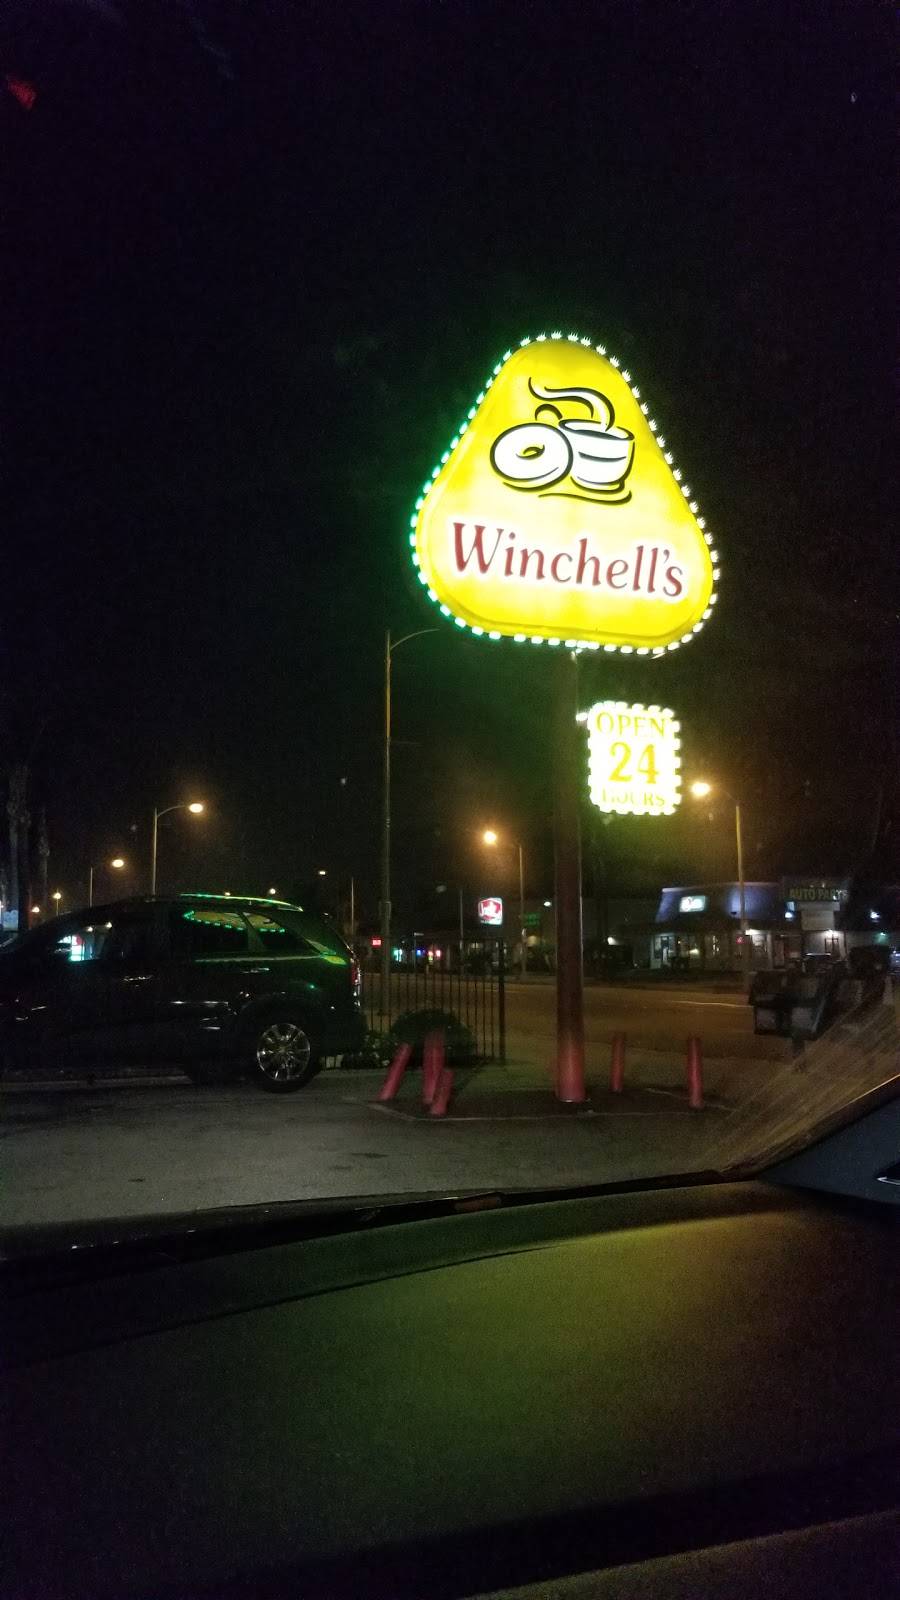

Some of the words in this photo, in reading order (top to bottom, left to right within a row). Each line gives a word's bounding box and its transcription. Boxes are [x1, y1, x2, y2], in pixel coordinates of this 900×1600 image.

[453, 522, 683, 597] Winchell's
[595, 711, 667, 737] OPEN
[608, 741, 660, 784] 24
[789, 886, 816, 901] AUTO
